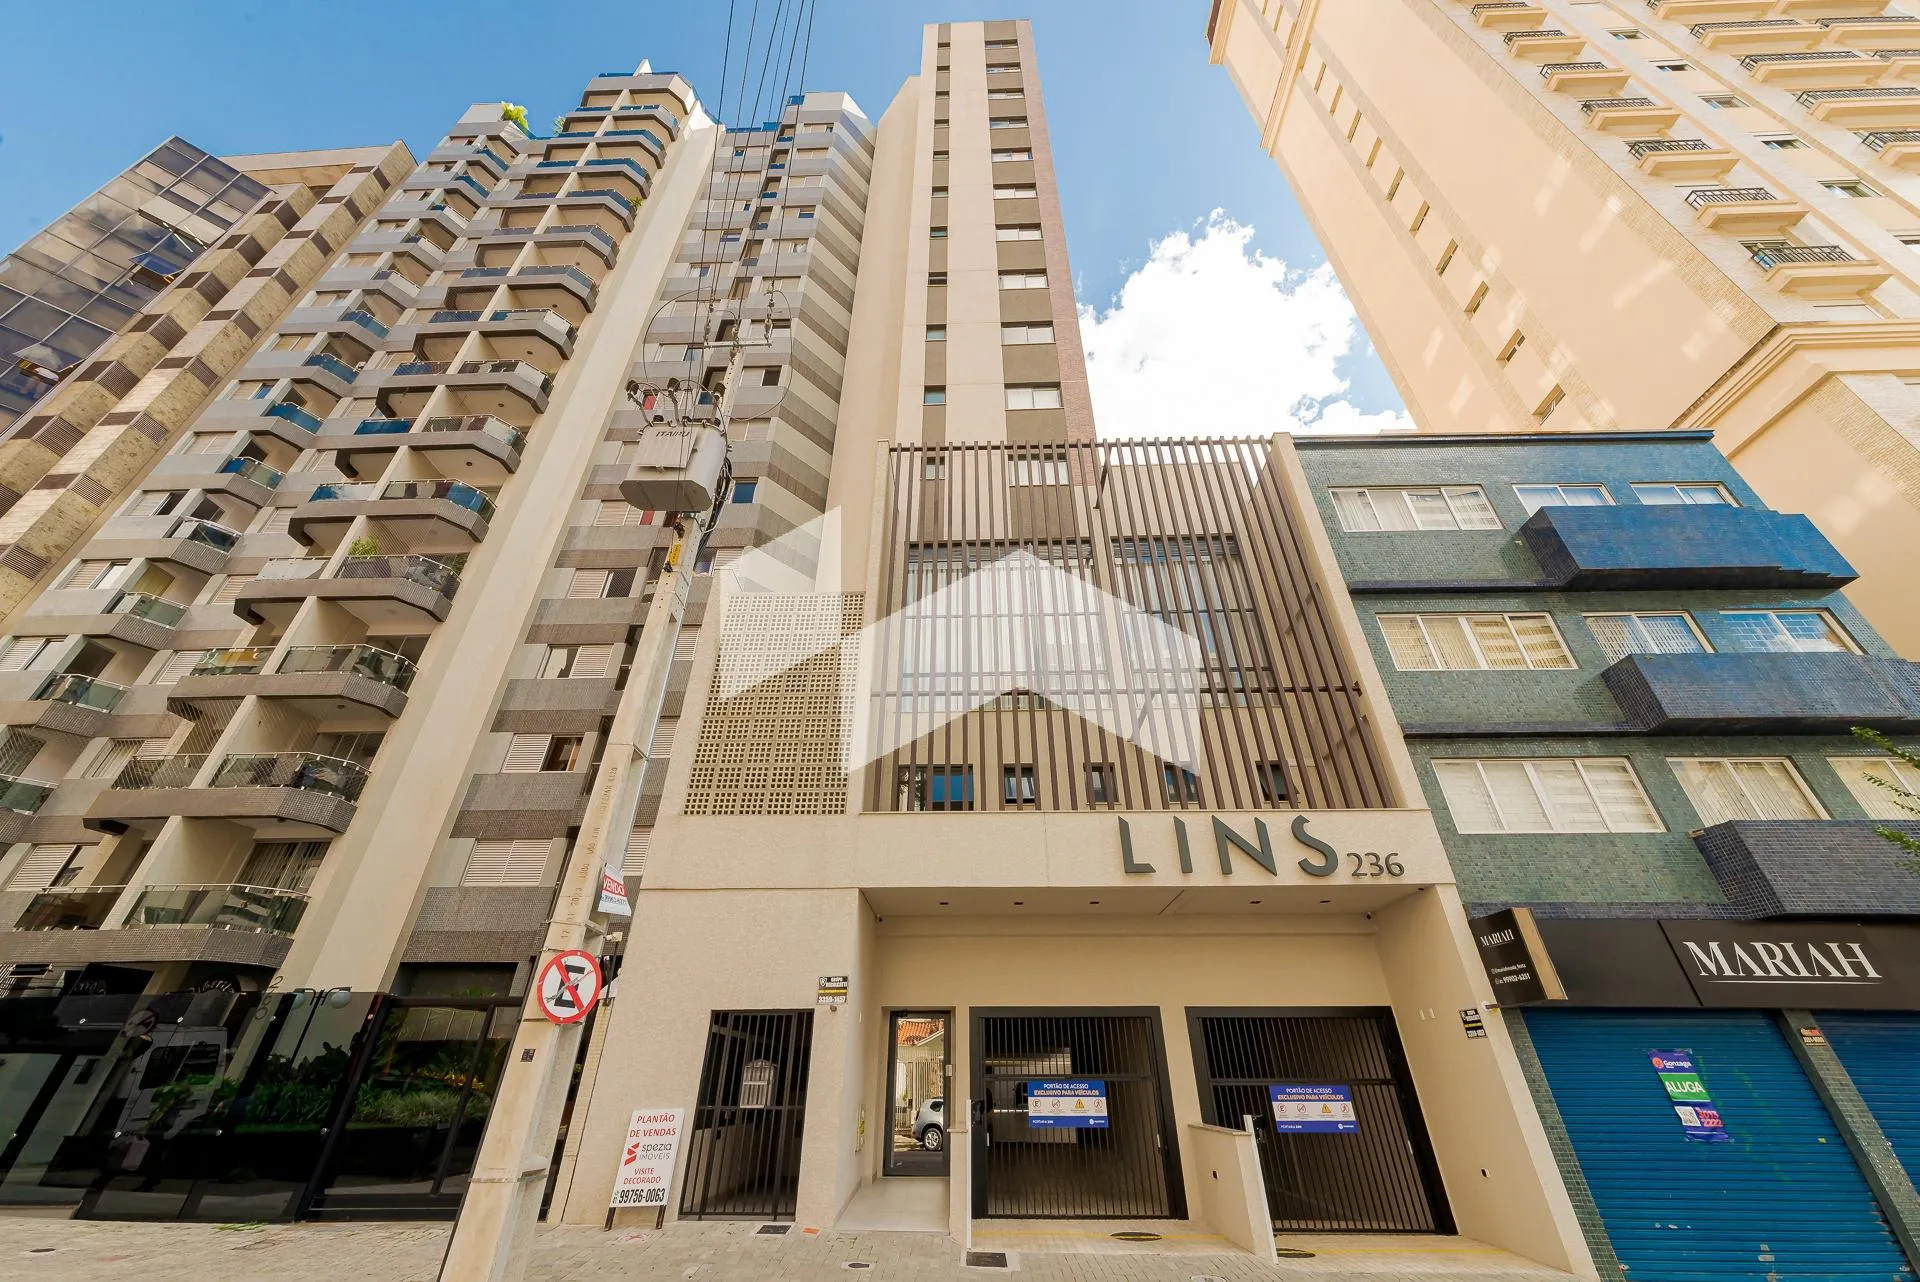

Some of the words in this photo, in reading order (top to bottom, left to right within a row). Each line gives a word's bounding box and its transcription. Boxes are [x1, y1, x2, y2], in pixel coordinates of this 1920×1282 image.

[1118, 814, 1339, 877] LINS
[1347, 852, 1405, 877] 236
[603, 877, 625, 895] VENDO
[1480, 929, 1515, 947] MARIAH
[1682, 941, 1883, 978] MARIAH
[1663, 1060, 1692, 1068] Gonzaga
[1665, 1081, 1706, 1093] ALUGA
[637, 1113, 675, 1124] PLANTÃO
[629, 1129, 640, 1138] DE
[643, 1127, 676, 1137] VENDAS
[641, 1143, 672, 1153] spezia
[639, 1152, 671, 1161] IMÓVEIS
[623, 1176, 661, 1185] DECORADO
[618, 1188, 666, 1204] 99756-0063
